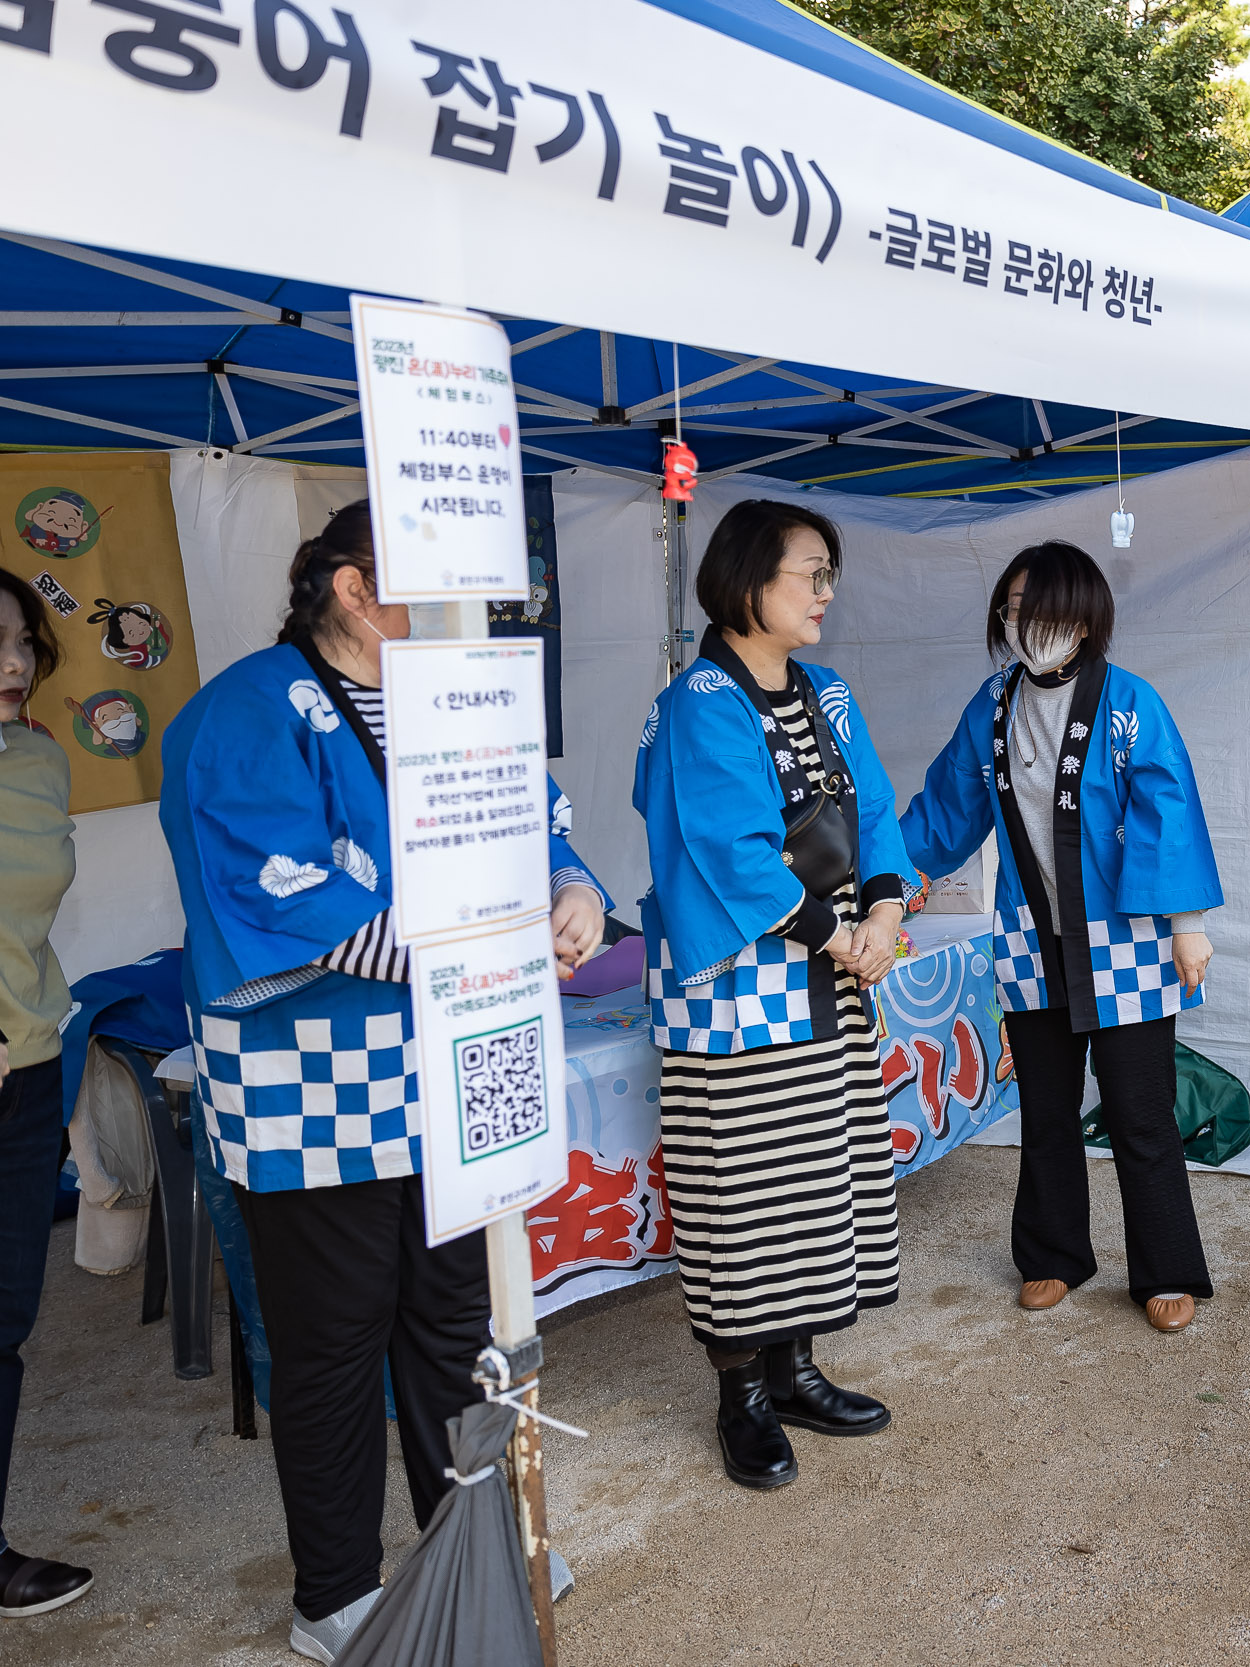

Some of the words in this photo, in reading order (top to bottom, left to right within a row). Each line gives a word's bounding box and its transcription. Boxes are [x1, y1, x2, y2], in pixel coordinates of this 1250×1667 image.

[410, 39, 623, 203] 잡기
[652, 110, 844, 265] 놀이)
[868, 206, 993, 287] -글로벌
[1002, 239, 1094, 313] 문화와
[1101, 264, 1163, 327] 청년-
[399, 461, 473, 482] 체험부스
[419, 428, 497, 451] 11:40부터
[1058, 721, 1089, 811] 御祭礼
